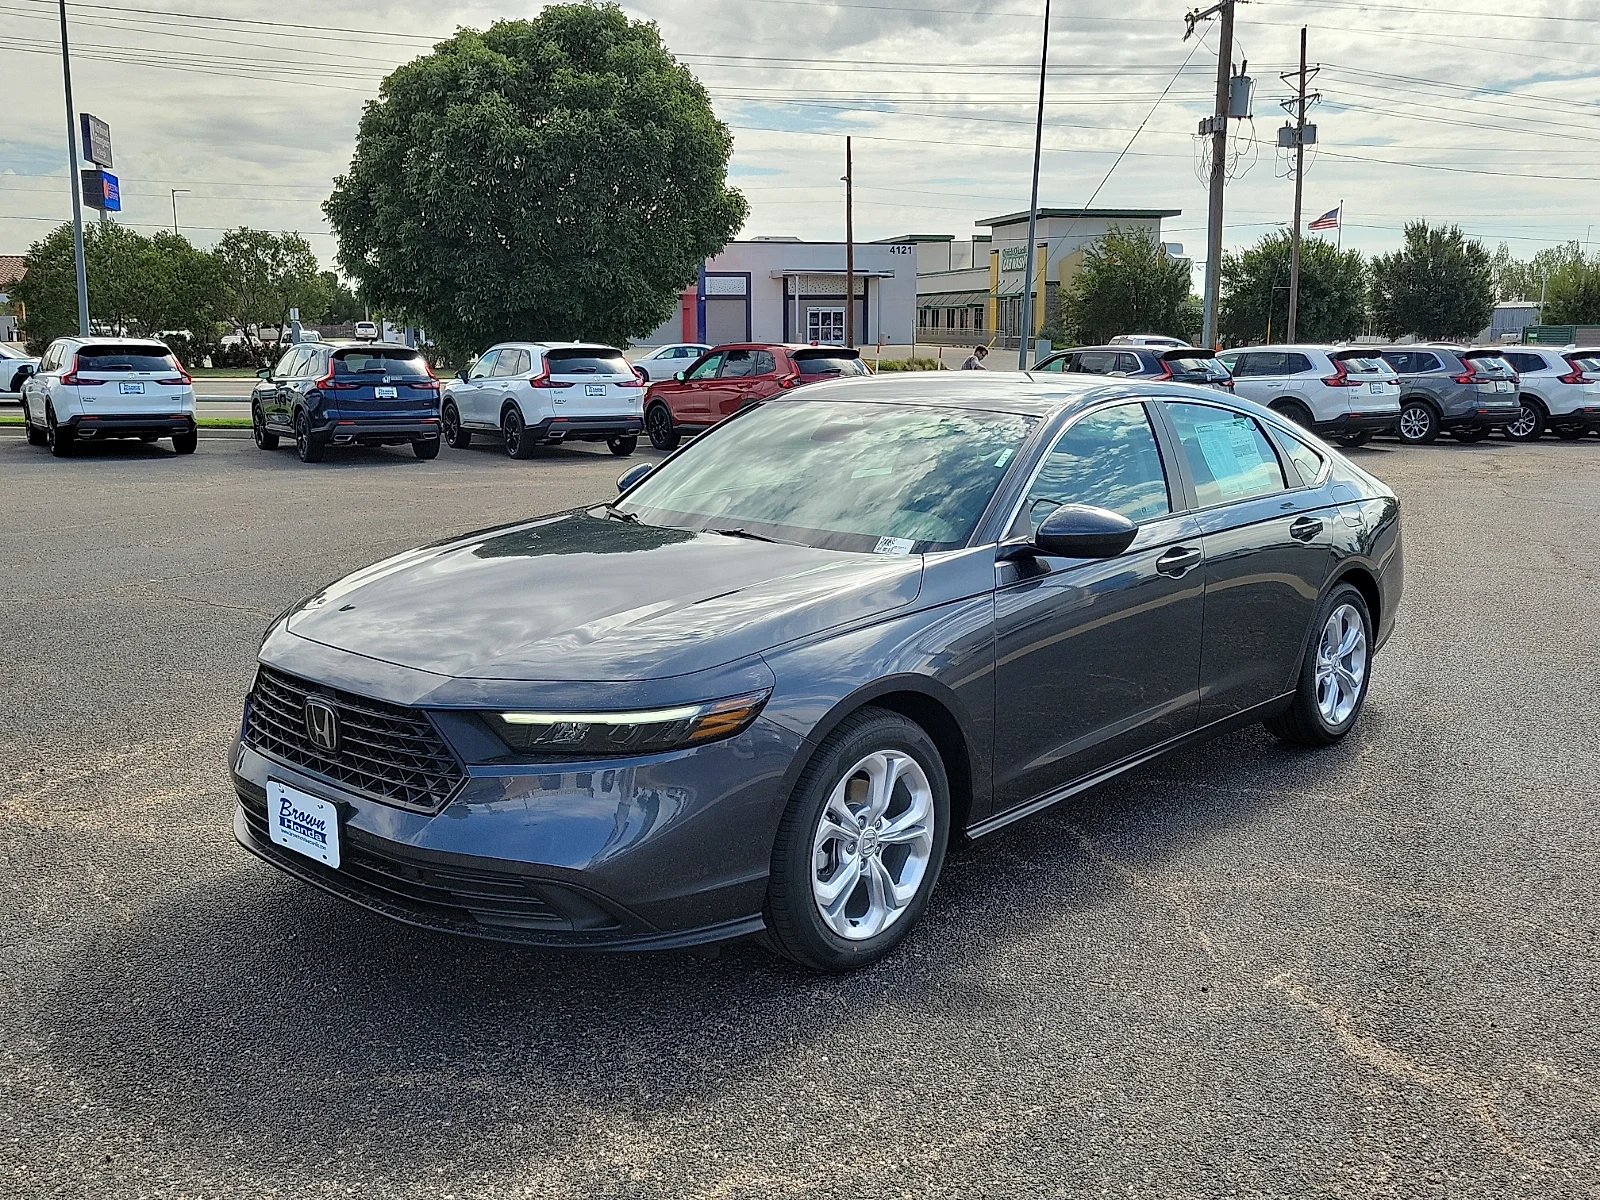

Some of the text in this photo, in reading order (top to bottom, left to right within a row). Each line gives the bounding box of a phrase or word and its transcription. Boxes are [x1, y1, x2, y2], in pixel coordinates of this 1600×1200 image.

[889, 245, 912, 255] 4121
[1002, 258, 1012, 270] CAR
[279, 797, 326, 831] Brown
[284, 818, 322, 842] Honda
